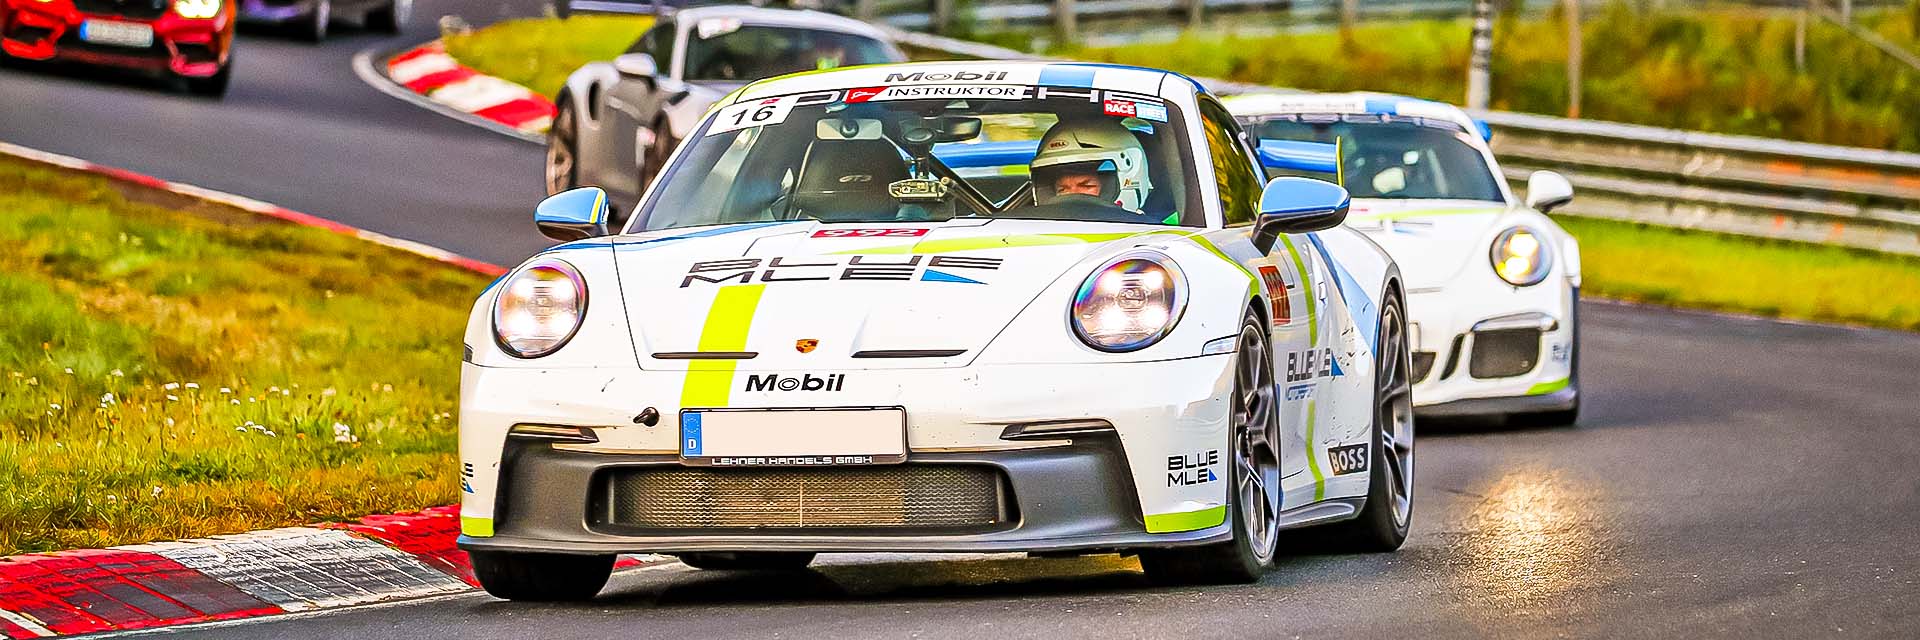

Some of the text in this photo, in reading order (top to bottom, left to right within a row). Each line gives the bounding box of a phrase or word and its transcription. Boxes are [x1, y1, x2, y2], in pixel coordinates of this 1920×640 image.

[884, 71, 1008, 83] Mobil
[887, 86, 1016, 97] INSTRUKTOR
[731, 105, 777, 126] 16
[1105, 103, 1134, 115] RACE
[823, 229, 915, 237] 992
[688, 255, 1004, 273] BLUE
[680, 267, 916, 288] MLE
[745, 374, 846, 391] Mobil
[687, 439, 697, 449] D
[711, 457, 766, 465] LEHNER
[769, 456, 832, 464] HANDELS
[1167, 449, 1219, 471] BLUE
[1331, 446, 1366, 475] BOSS
[1167, 468, 1209, 488] MLE
